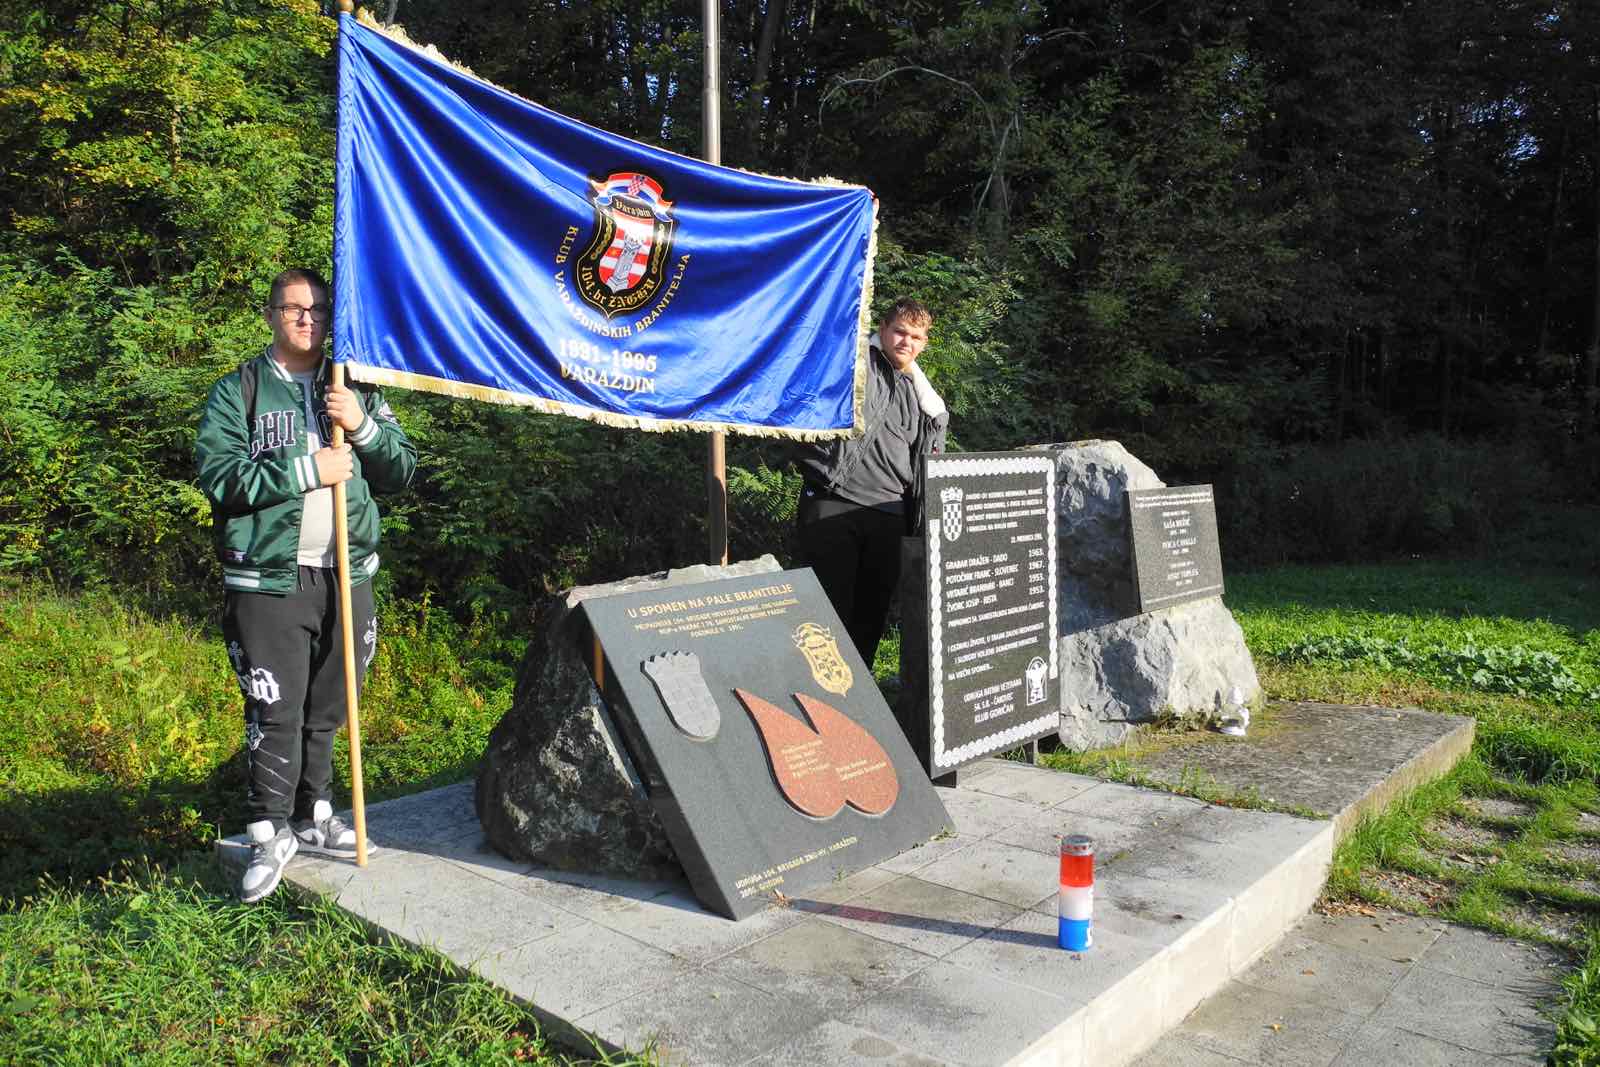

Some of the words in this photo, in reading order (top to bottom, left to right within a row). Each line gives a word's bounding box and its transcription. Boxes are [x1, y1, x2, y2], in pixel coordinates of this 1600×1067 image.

[555, 226, 579, 264] KLUB
[635, 254, 691, 333] BRANITELJA
[559, 338, 657, 372] 1991-1995
[627, 608, 637, 618] U
[639, 602, 687, 617] SPOMEN
[688, 598, 704, 609] NA
[706, 594, 731, 606] PALE
[735, 583, 793, 601] BRANITELJE
